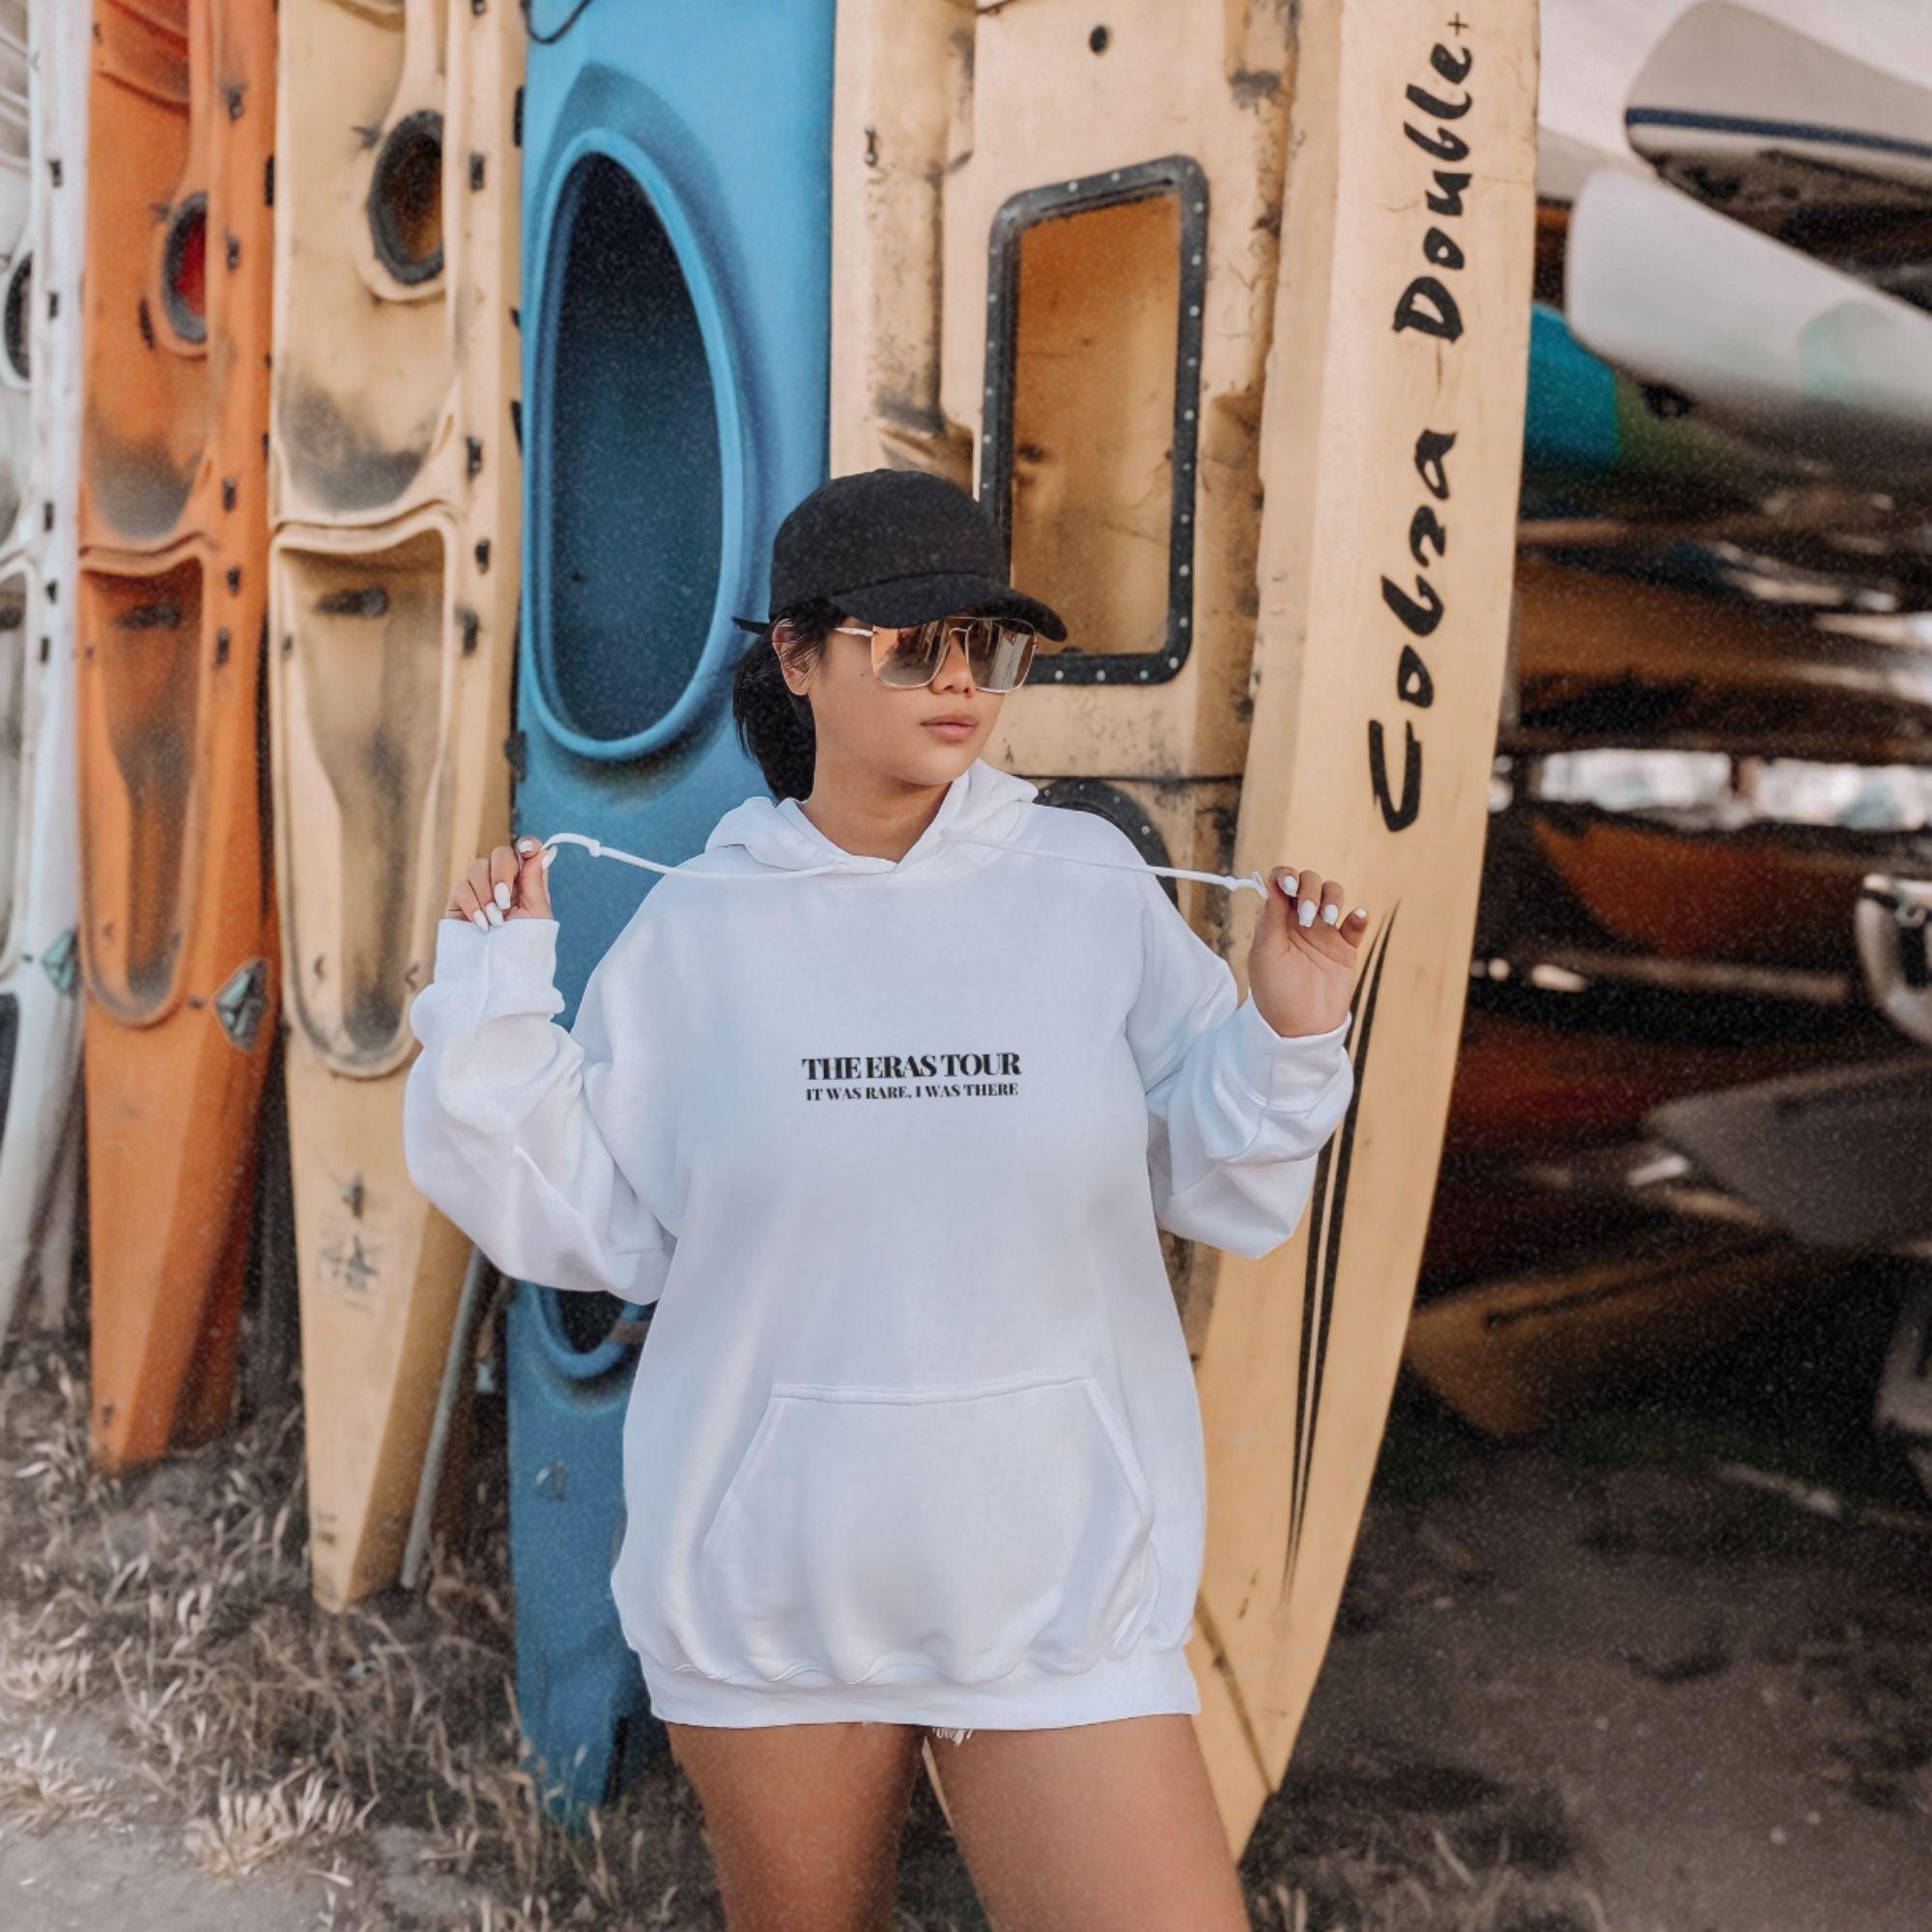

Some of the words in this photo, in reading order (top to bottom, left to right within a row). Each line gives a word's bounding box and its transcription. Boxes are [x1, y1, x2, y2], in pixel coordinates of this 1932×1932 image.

[1368, 428, 1458, 833] Cobra
[801, 1057, 862, 1080] THE
[866, 1055, 938, 1078] ERAS
[940, 1052, 1022, 1076] TOUR
[806, 1087, 824, 1101] IT
[826, 1086, 862, 1101] WAS
[916, 1085, 923, 1098] I
[924, 1083, 961, 1097] WAS
[963, 1082, 1018, 1097] THERE
